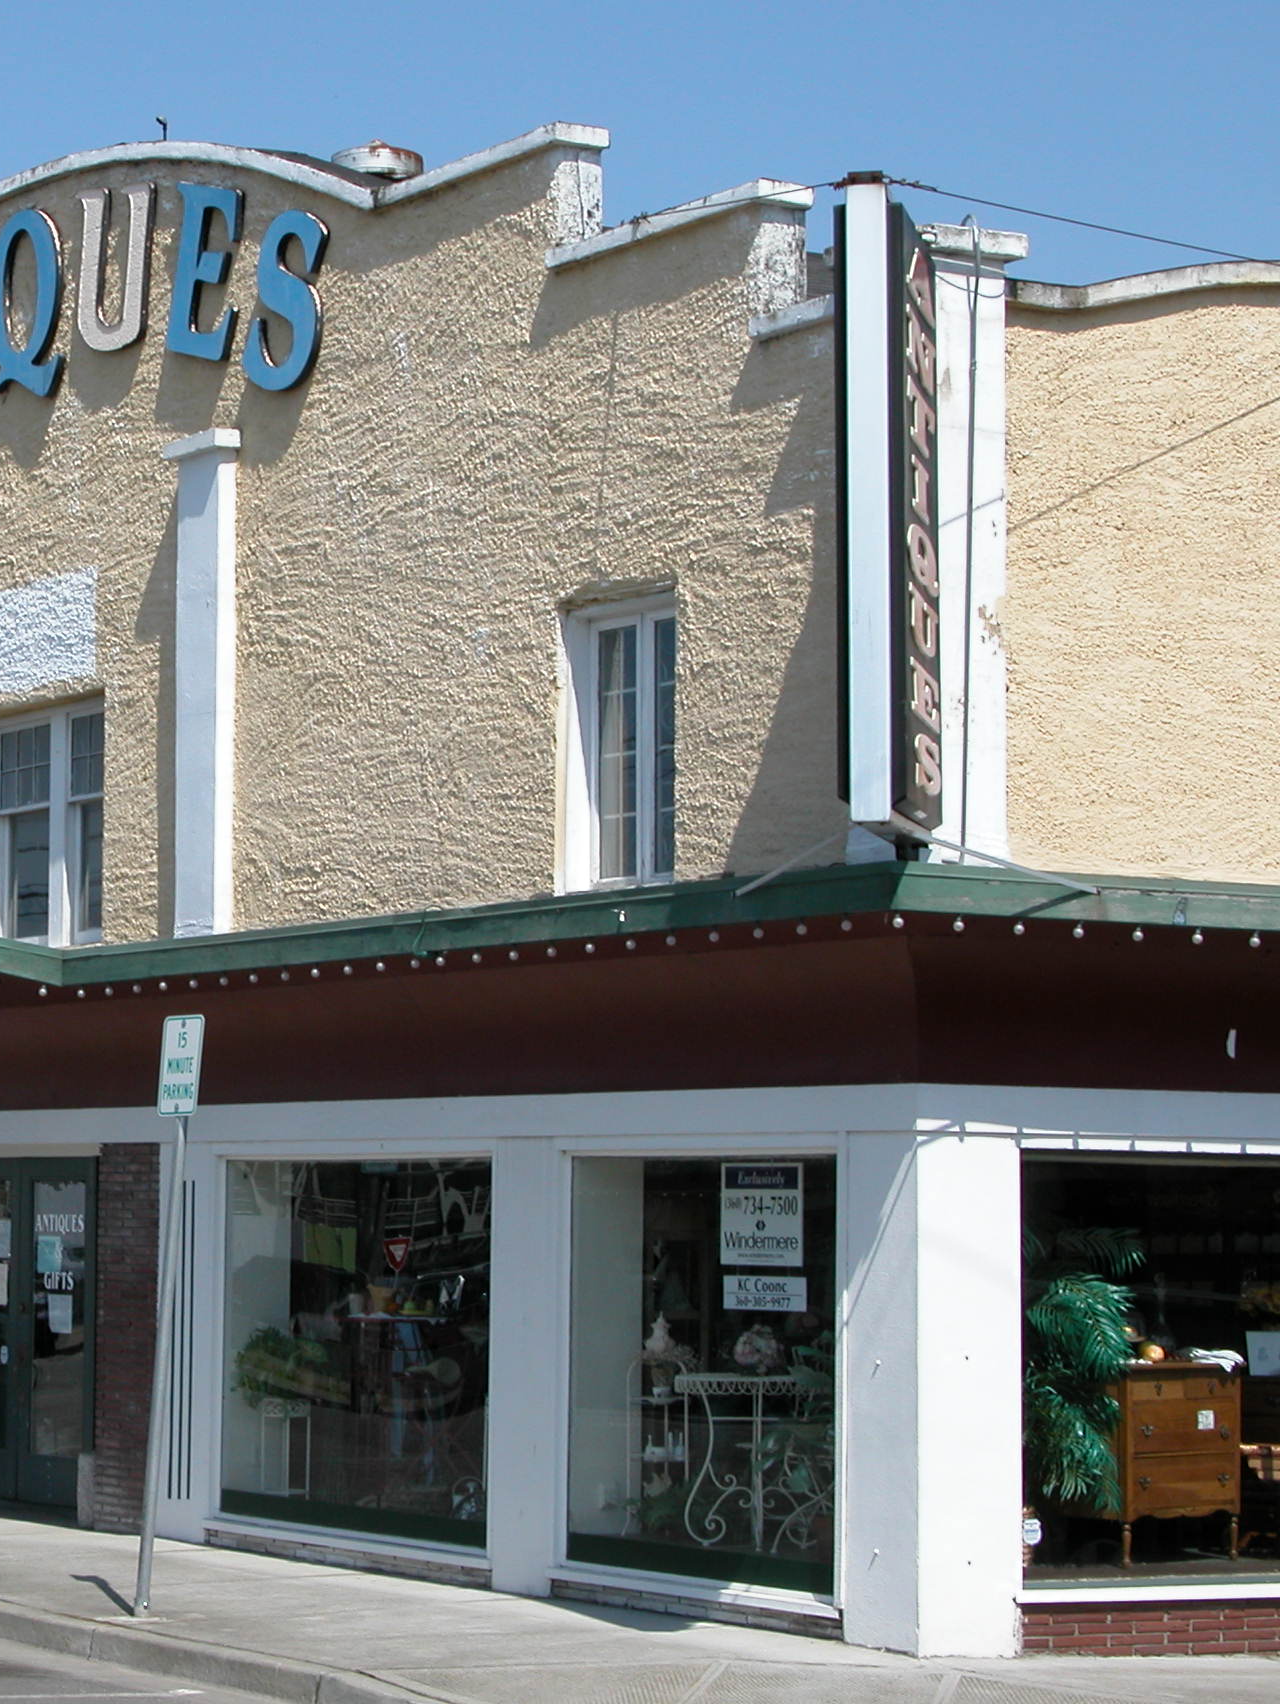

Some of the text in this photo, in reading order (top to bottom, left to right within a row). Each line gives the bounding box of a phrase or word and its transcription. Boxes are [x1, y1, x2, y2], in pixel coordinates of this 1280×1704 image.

[906, 246, 940, 797] ANTIQUES
[178, 1031, 188, 1049] 15
[167, 1057, 194, 1074] MINUTE
[162, 1082, 194, 1100] PARKING
[737, 1170, 786, 1188] Exclusively
[743, 1195, 799, 1216] 734-7500
[35, 1213, 85, 1234] ANTIQUES
[723, 1231, 799, 1250] Windermere
[43, 1271, 75, 1291] GIFTS
[737, 1278, 751, 1292] KC
